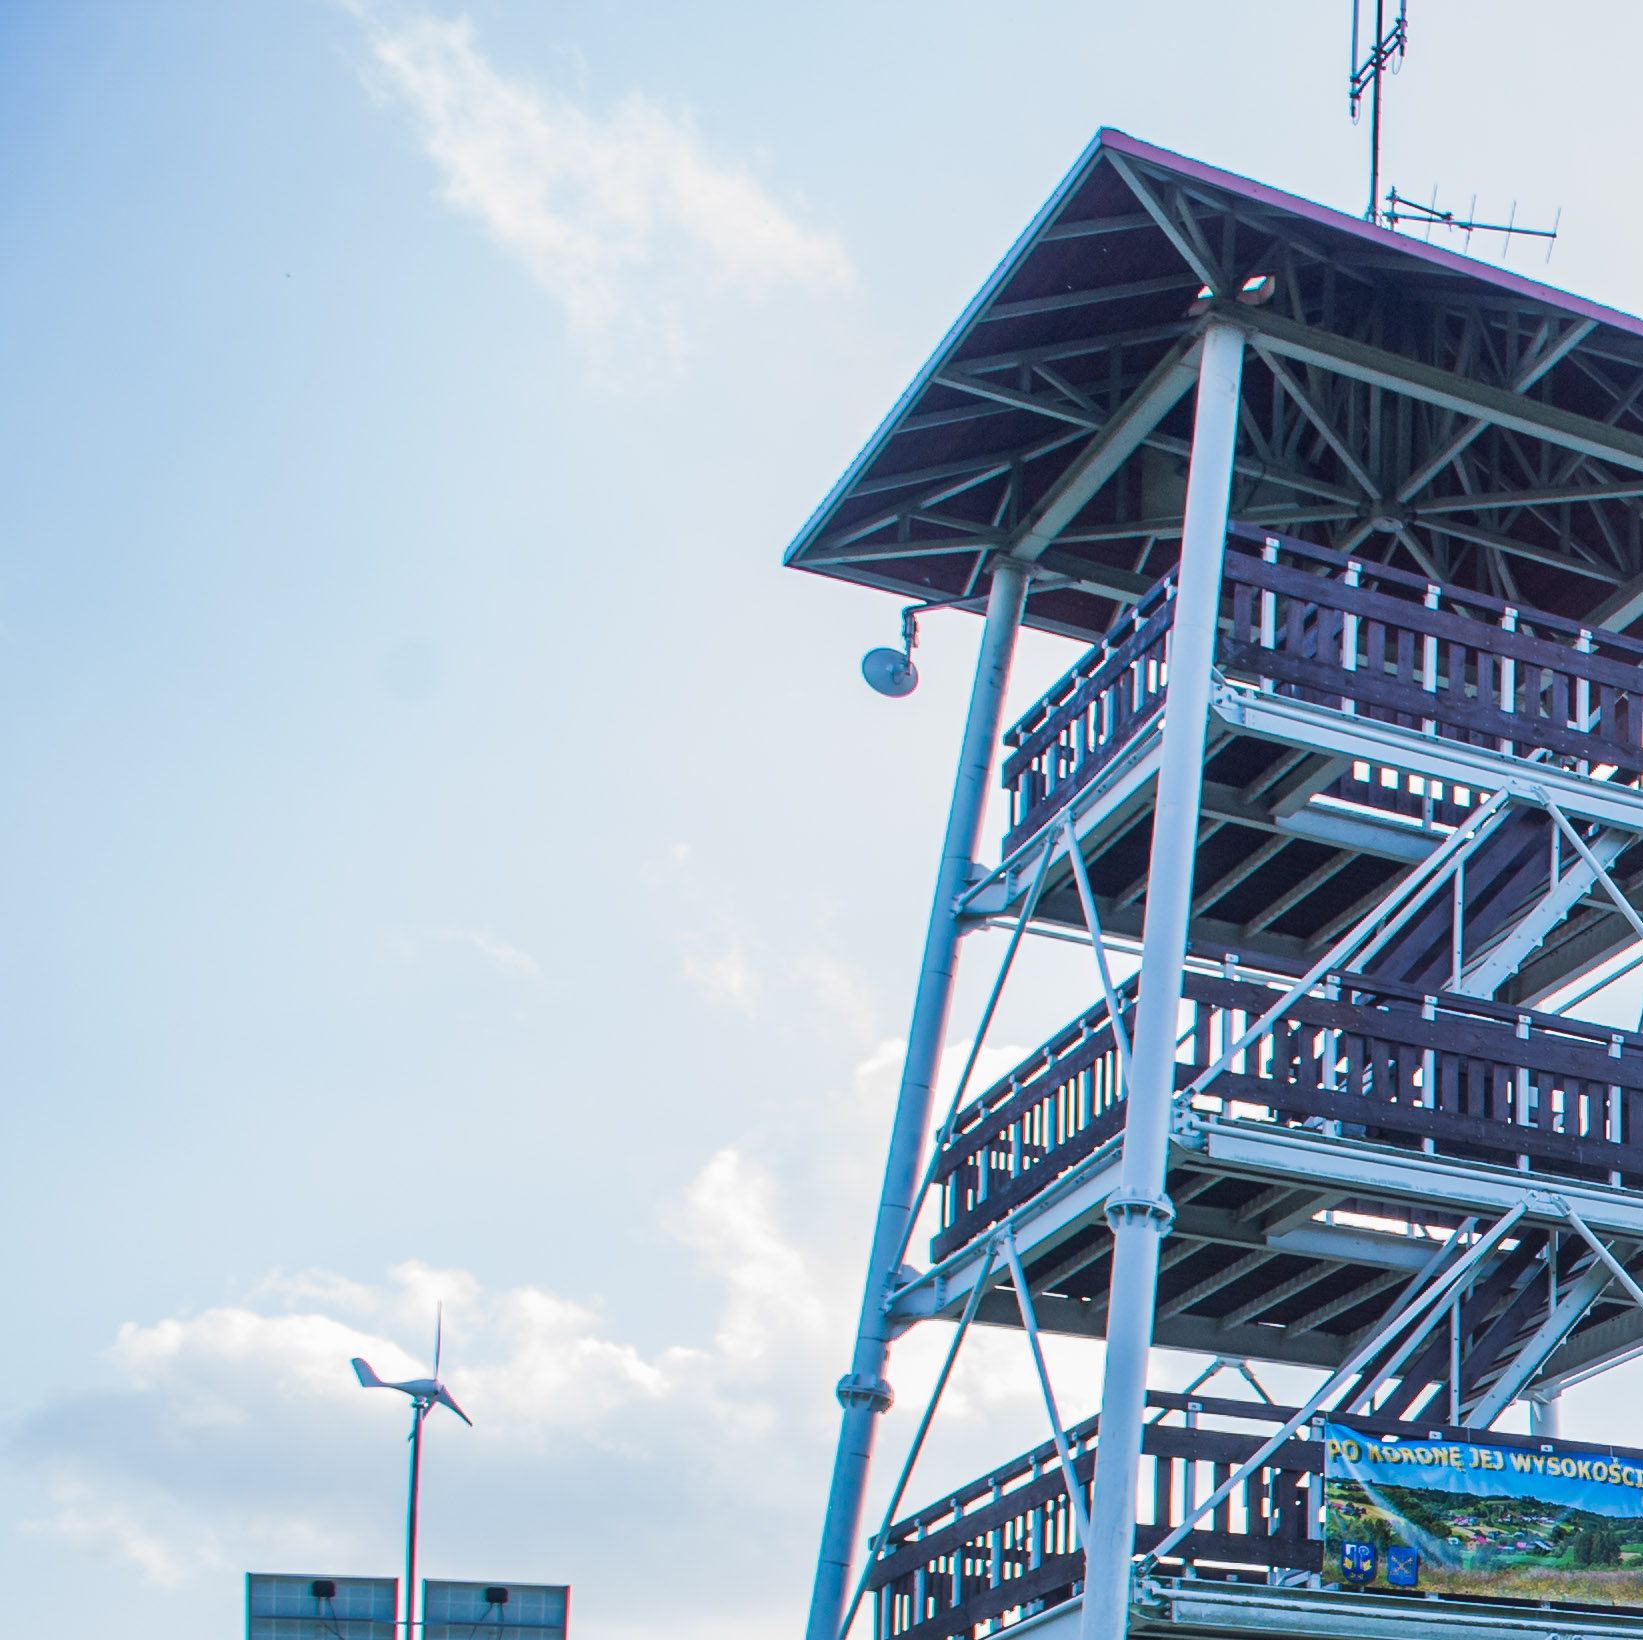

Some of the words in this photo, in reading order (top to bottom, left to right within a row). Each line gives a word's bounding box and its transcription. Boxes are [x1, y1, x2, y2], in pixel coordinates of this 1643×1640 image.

[1328, 1440, 1359, 1462] PO
[1368, 1441, 1464, 1473] KORONĘ
[1469, 1447, 1504, 1470] JEJ
